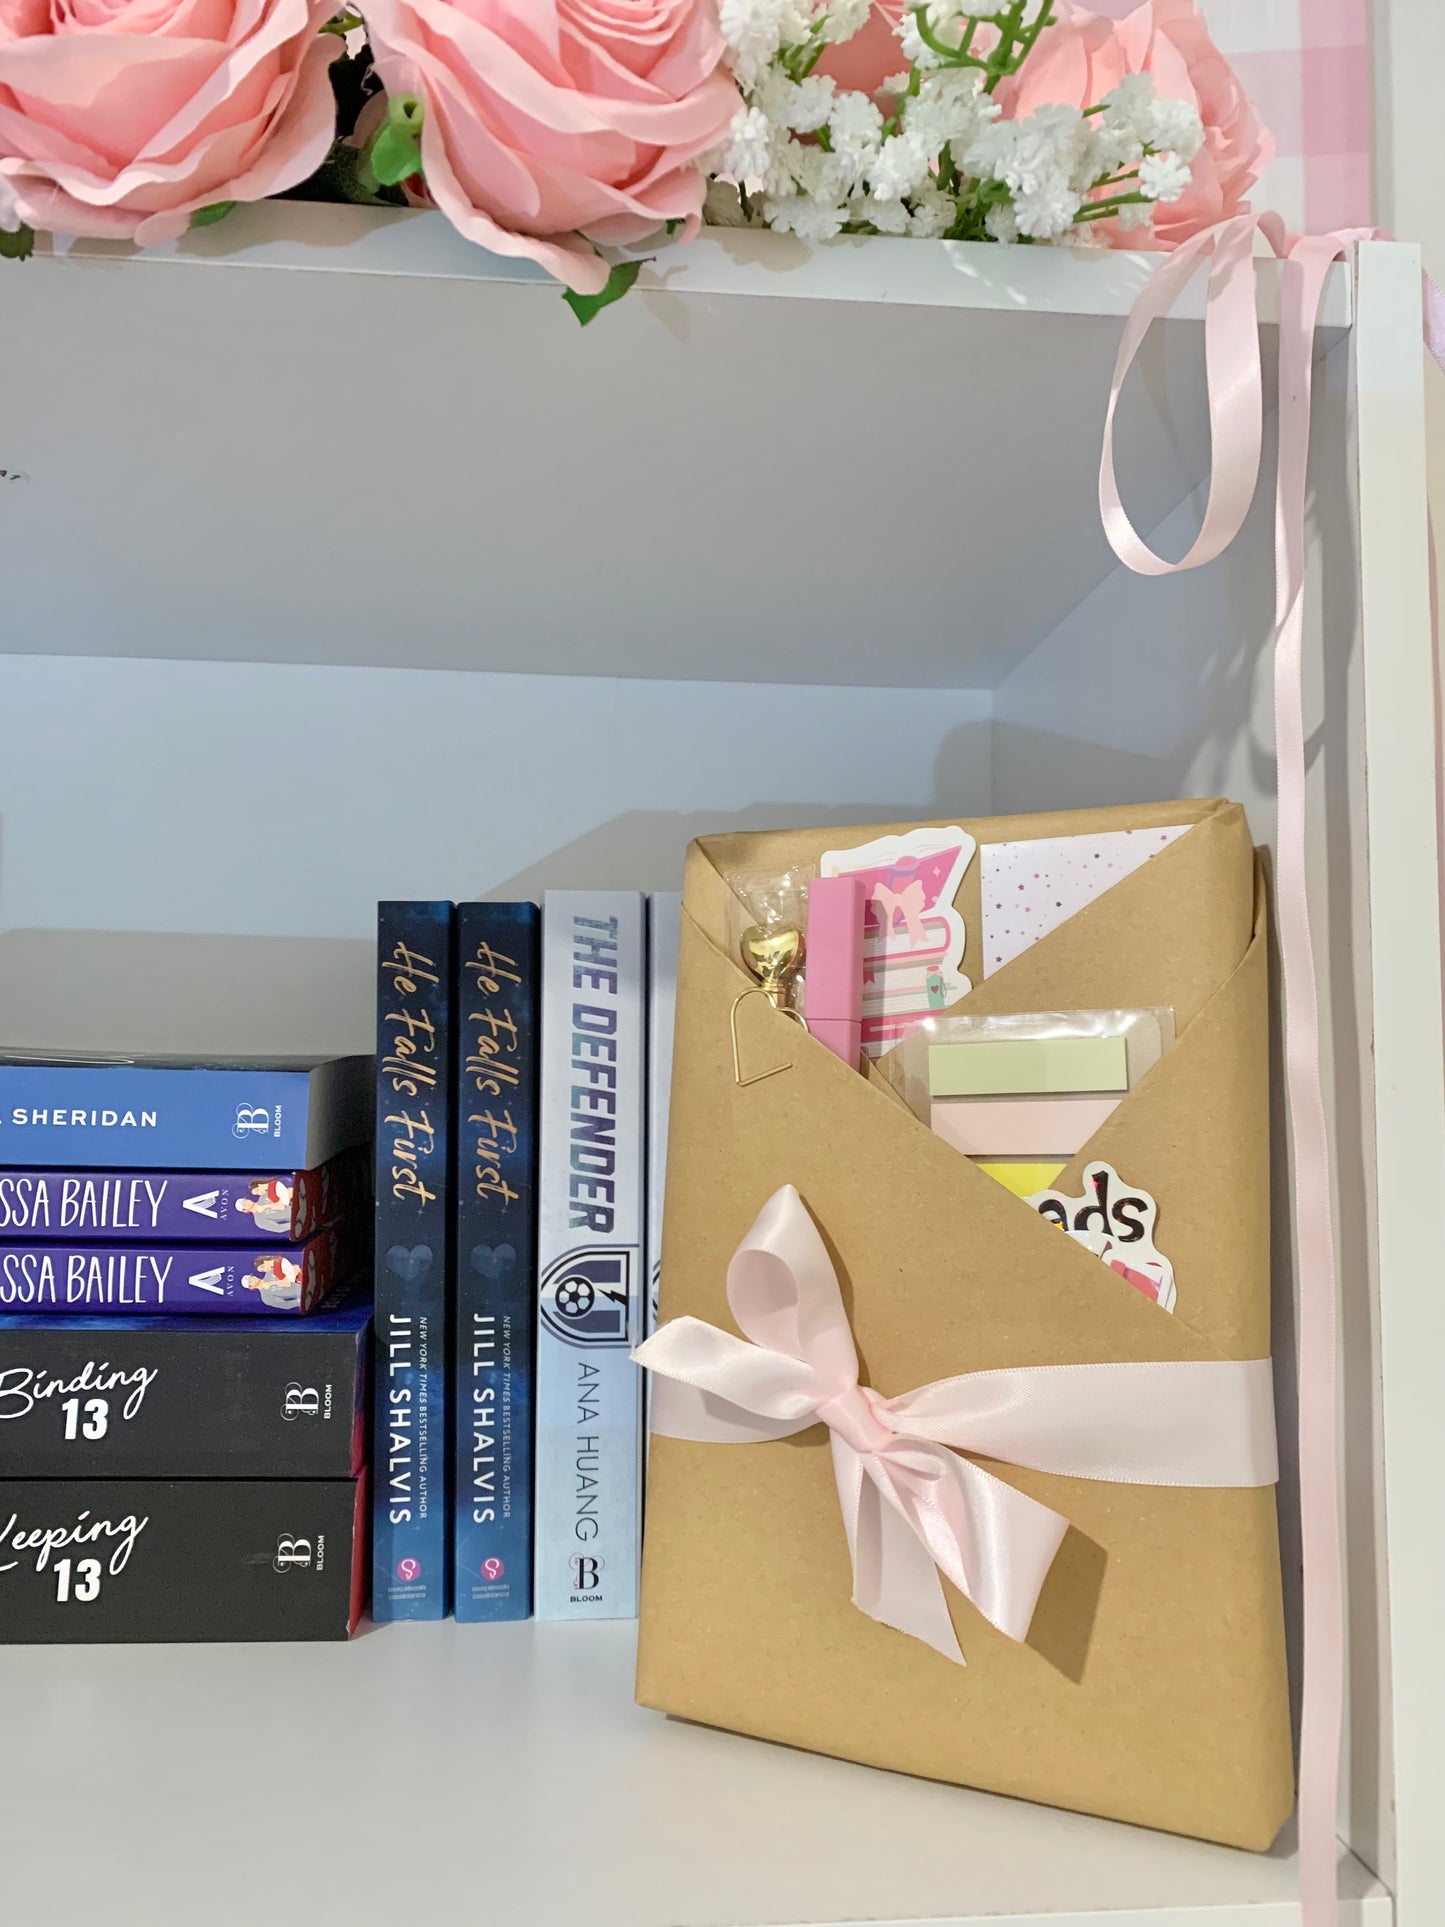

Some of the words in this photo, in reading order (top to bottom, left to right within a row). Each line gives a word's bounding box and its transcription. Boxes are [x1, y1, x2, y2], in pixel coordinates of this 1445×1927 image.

[382, 941, 440, 996] He
[465, 941, 522, 996] He
[573, 915, 618, 994] THE
[382, 1008, 437, 1097] Falls
[465, 1008, 520, 1097] Falls
[12, 1108, 157, 1127] SHERIDAN
[273, 1105, 282, 1137] BLOOM
[568, 1003, 617, 1234] DEFENDER
[384, 1110, 437, 1207] First
[468, 1110, 519, 1207] First
[60, 1179, 168, 1228] BAILEY
[221, 1189, 229, 1221] AVON
[0, 1255, 56, 1304] SSA
[67, 1256, 173, 1304] BAILEY
[227, 1265, 235, 1297] AVON
[389, 1314, 411, 1377] JILL
[419, 1316, 427, 1340] NEW
[473, 1313, 495, 1376] JILL
[503, 1315, 511, 1339] NEW
[419, 1343, 427, 1370] YORK
[503, 1342, 511, 1369] YORK
[0, 1361, 158, 1420] Binding
[324, 1384, 332, 1419] BLOOM
[419, 1374, 427, 1403] TIMES
[503, 1373, 511, 1402] TIMES
[577, 1362, 600, 1424] ANA
[62, 1398, 109, 1440] 13
[419, 1406, 427, 1472] BESTSELLING
[503, 1405, 511, 1472] BESTSELLING
[389, 1388, 411, 1524] SHALVIS
[473, 1388, 495, 1524] SHALVIS
[419, 1476, 427, 1518] AUTHOR
[503, 1475, 511, 1518] AUTHOR
[575, 1436, 600, 1542] HUANG
[316, 1535, 325, 1571] BLOOM
[53, 1558, 101, 1602] 13
[570, 1594, 603, 1602] BLOOM
